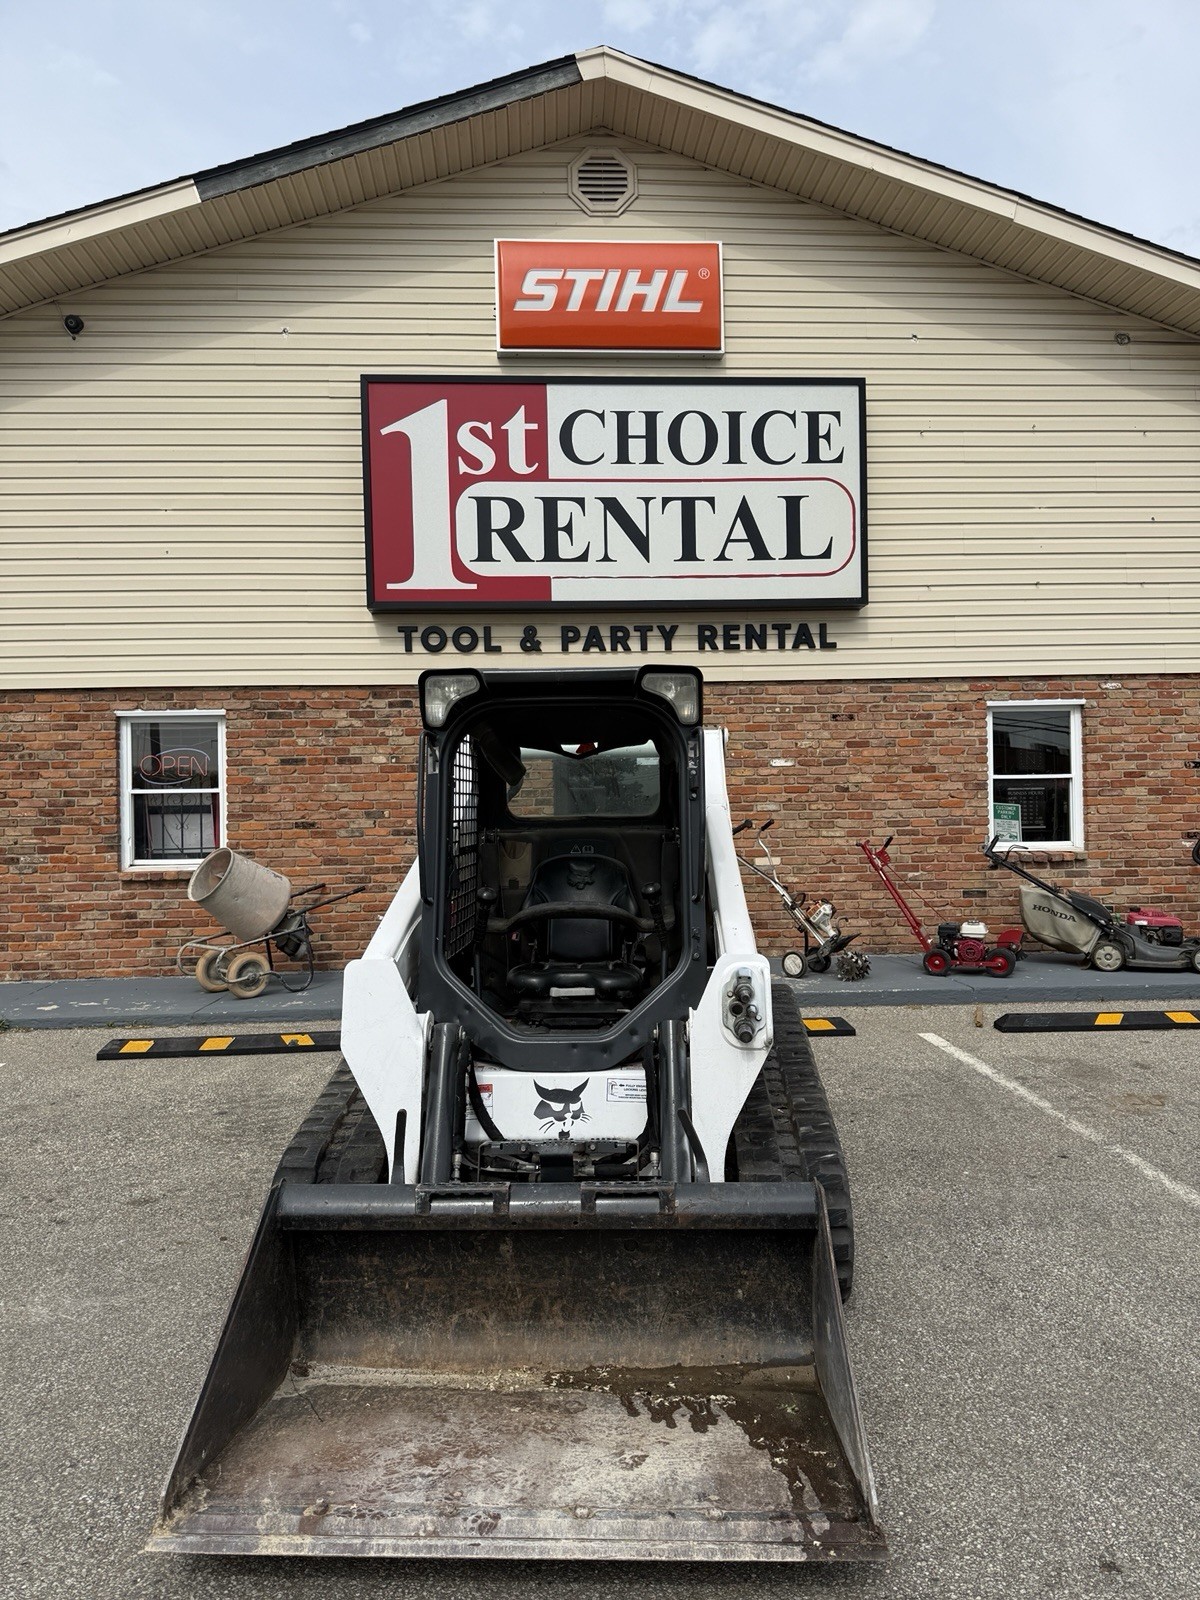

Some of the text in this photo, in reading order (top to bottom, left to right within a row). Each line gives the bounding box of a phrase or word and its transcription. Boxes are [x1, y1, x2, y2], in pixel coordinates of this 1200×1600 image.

[380, 398, 845, 590] 1st CHOICE
[468, 494, 835, 564] RENTAL
[397, 622, 837, 654] TOOL & PARTY RENTAL
[140, 754, 208, 777] OPEN
[1032, 904, 1077, 923] HONDA
